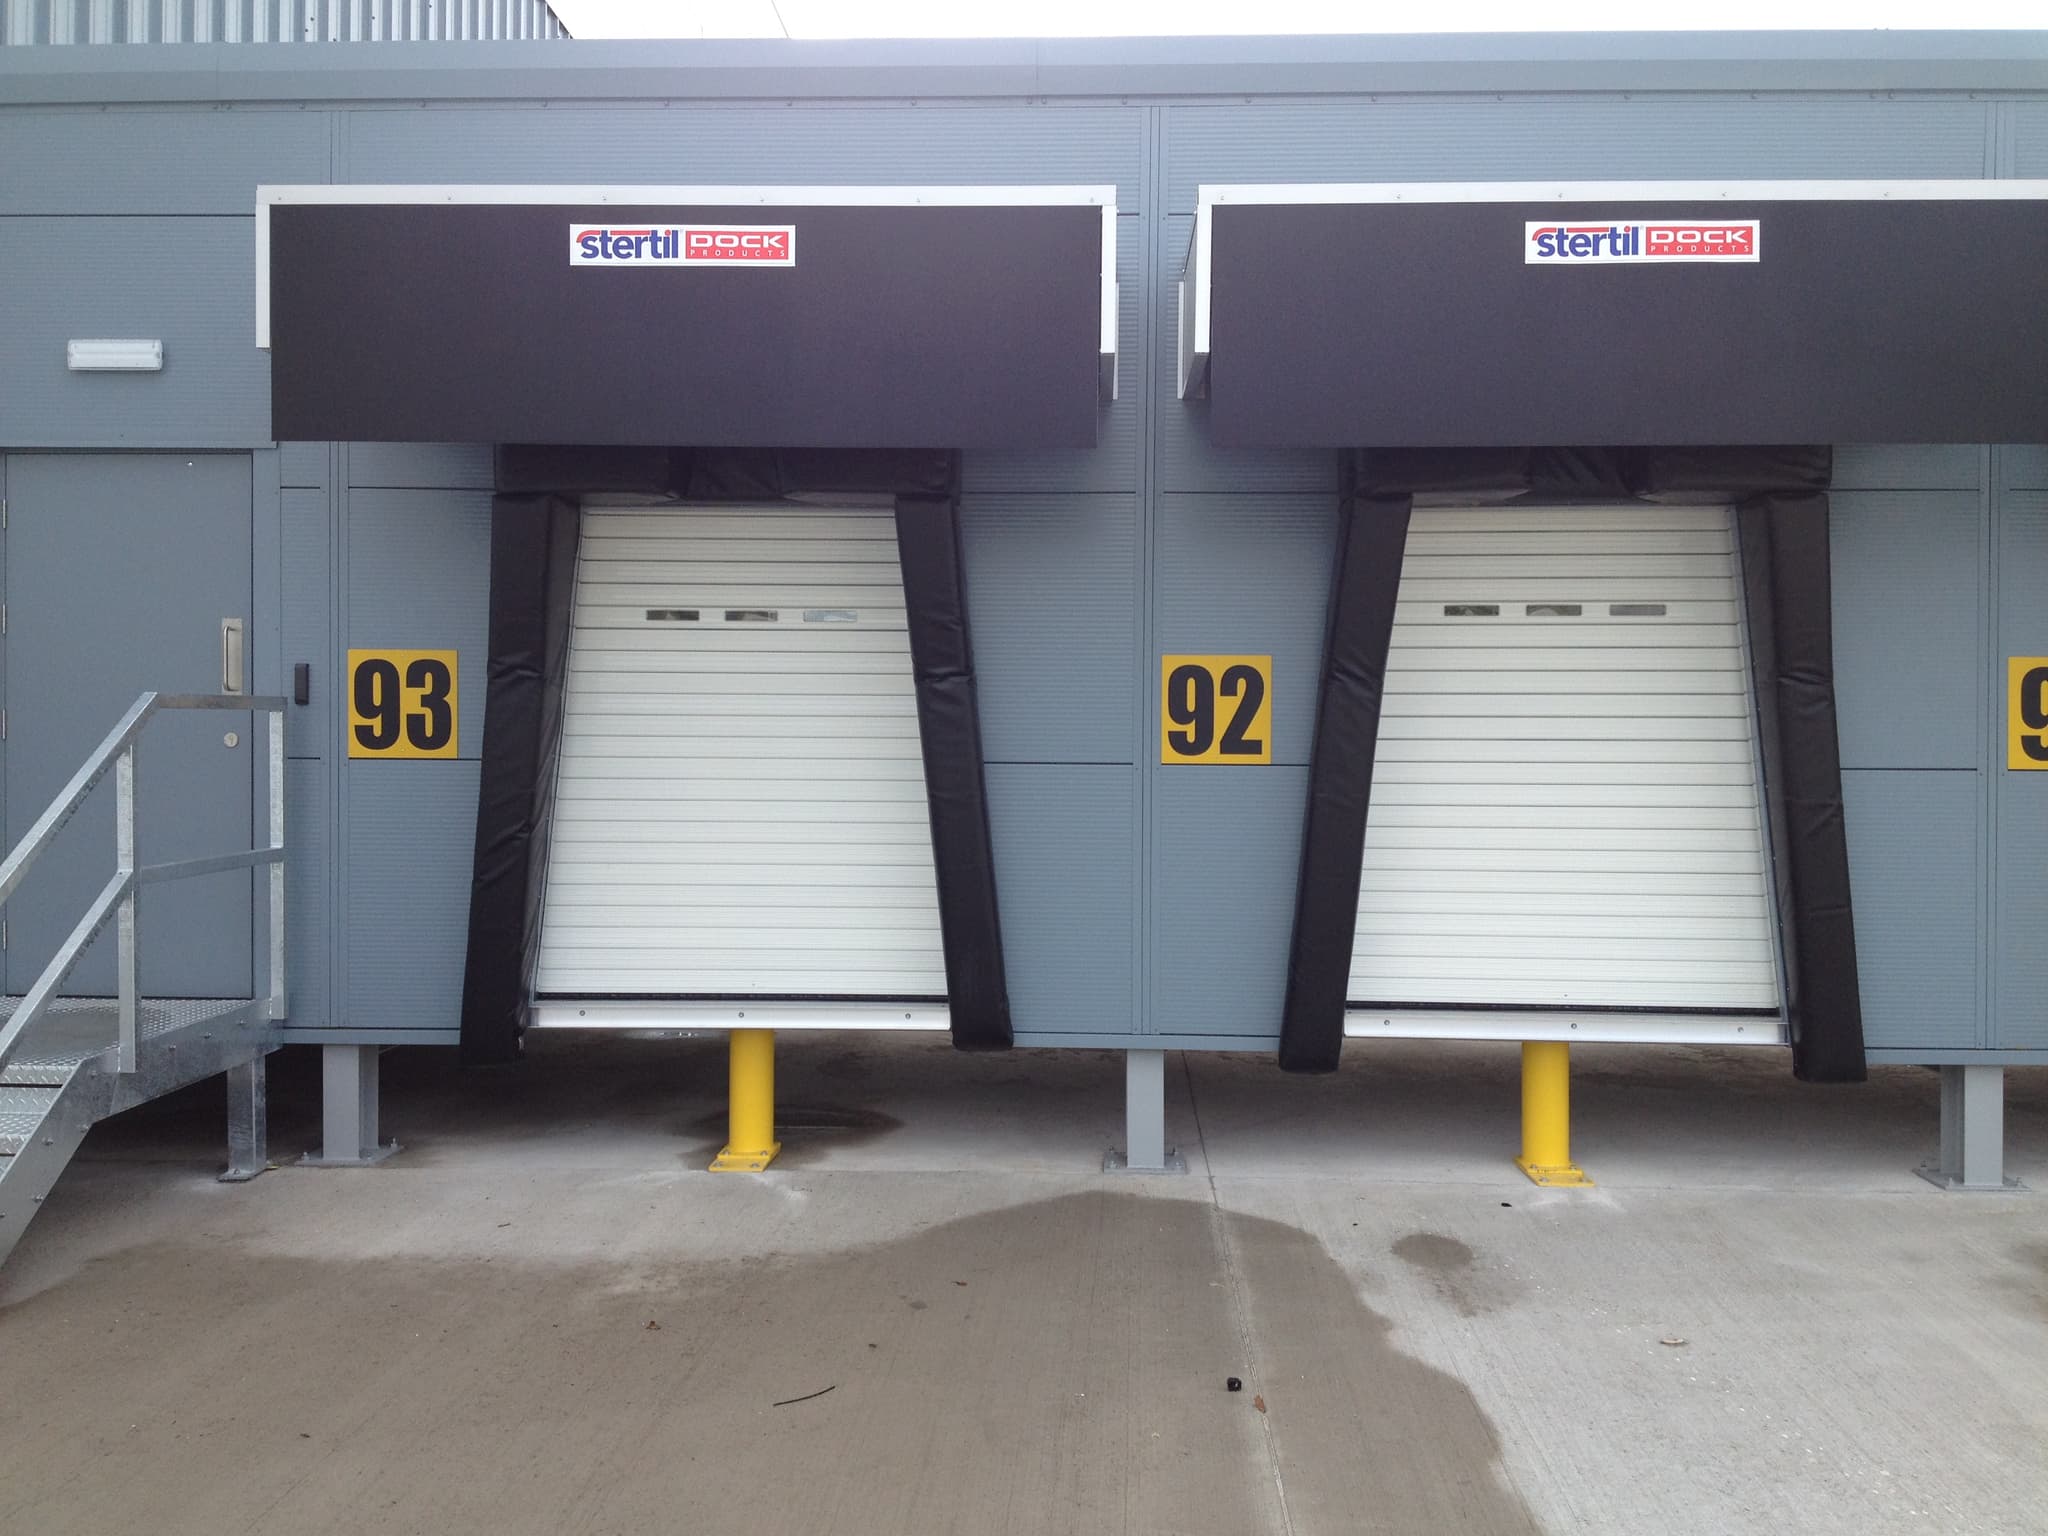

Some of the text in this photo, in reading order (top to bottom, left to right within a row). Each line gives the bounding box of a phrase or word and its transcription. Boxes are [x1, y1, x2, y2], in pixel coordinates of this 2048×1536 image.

[577, 229, 679, 259] stertil
[690, 234, 784, 248] DOCK
[1534, 226, 1639, 257] stertil
[1650, 230, 1748, 244] DOCK
[690, 249, 785, 257] PRODUCTS
[1651, 244, 1750, 253] PRODUCTS
[354, 658, 452, 750] 93
[1168, 664, 1265, 756] 92
